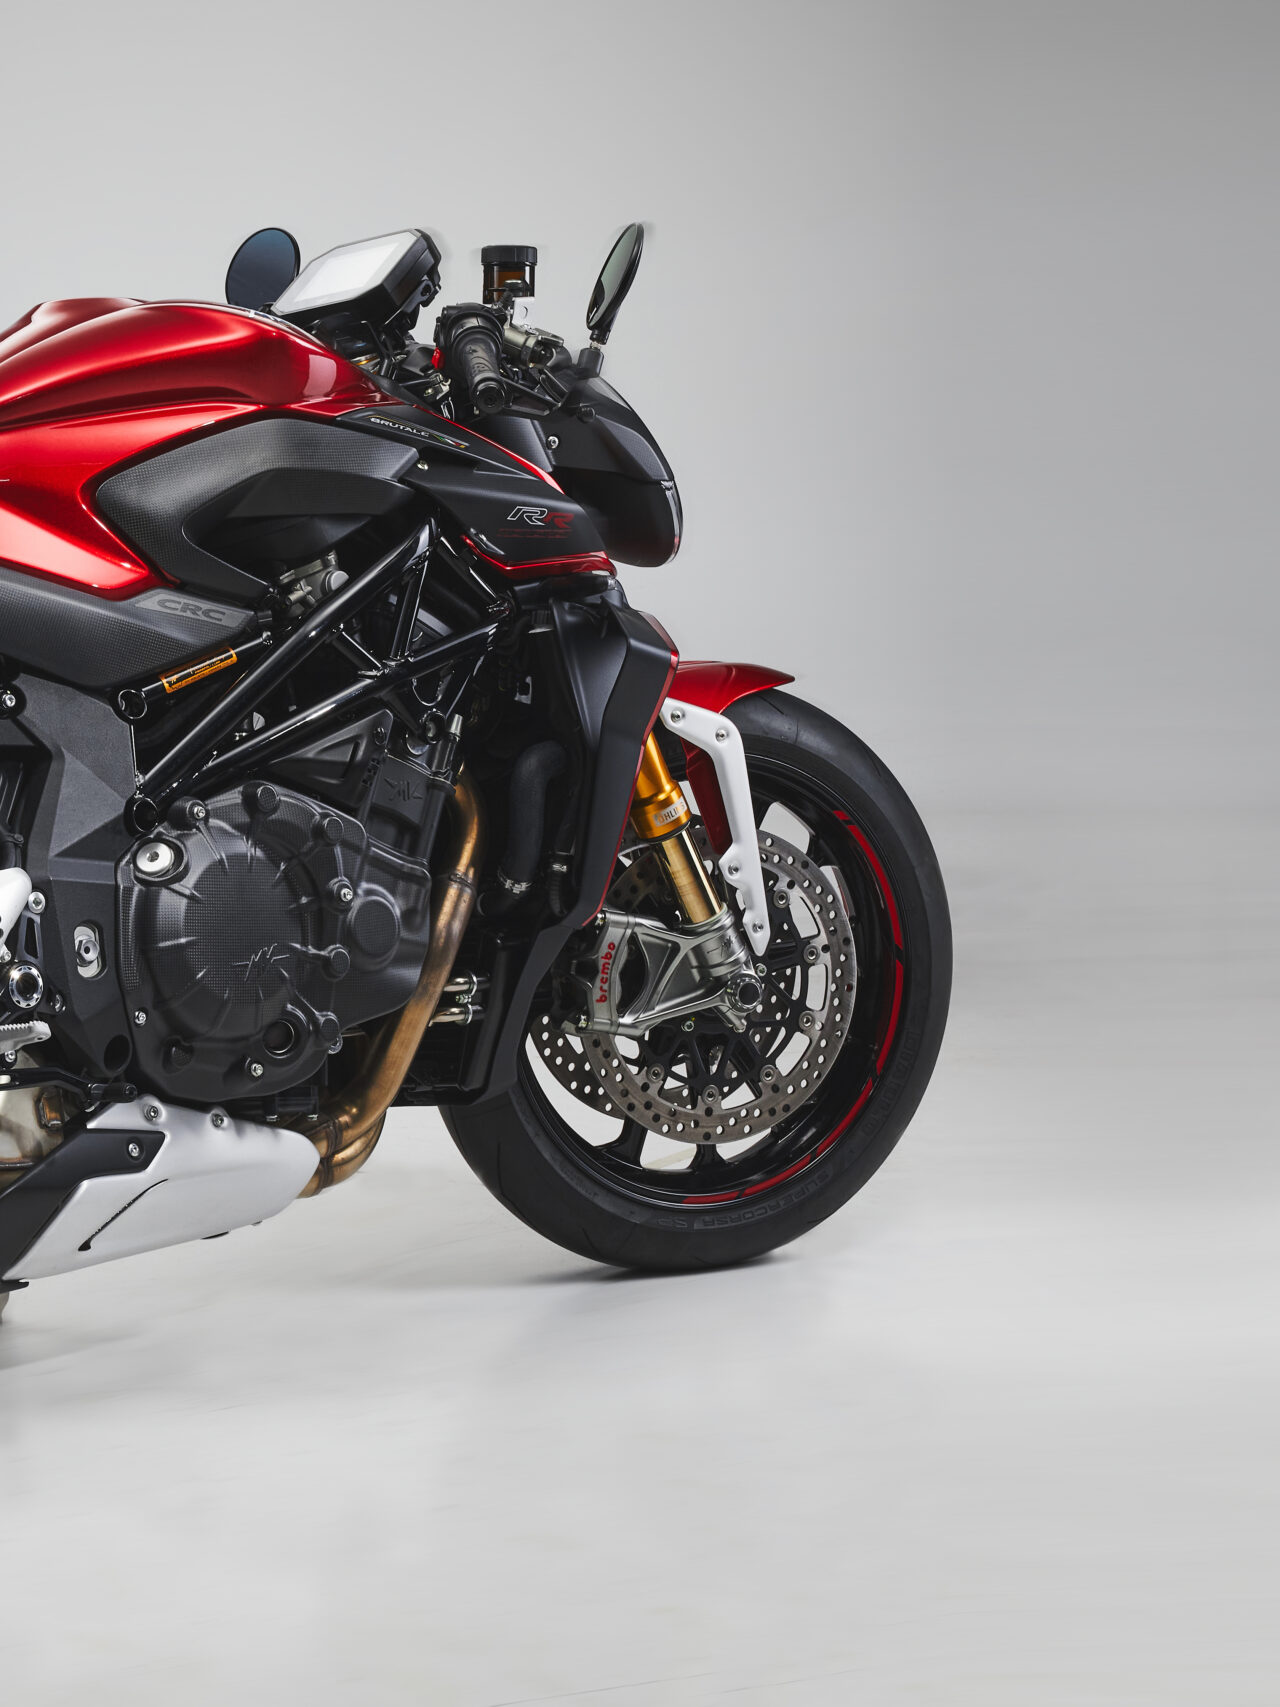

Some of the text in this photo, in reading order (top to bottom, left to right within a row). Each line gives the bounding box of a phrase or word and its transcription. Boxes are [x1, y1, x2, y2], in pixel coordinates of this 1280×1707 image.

[370, 417, 430, 437] BRUTALE
[507, 506, 575, 528] RR
[157, 599, 226, 622] CRC
[595, 941, 616, 1004] brembo
[701, 1169, 831, 1226] SUPERCORSA
